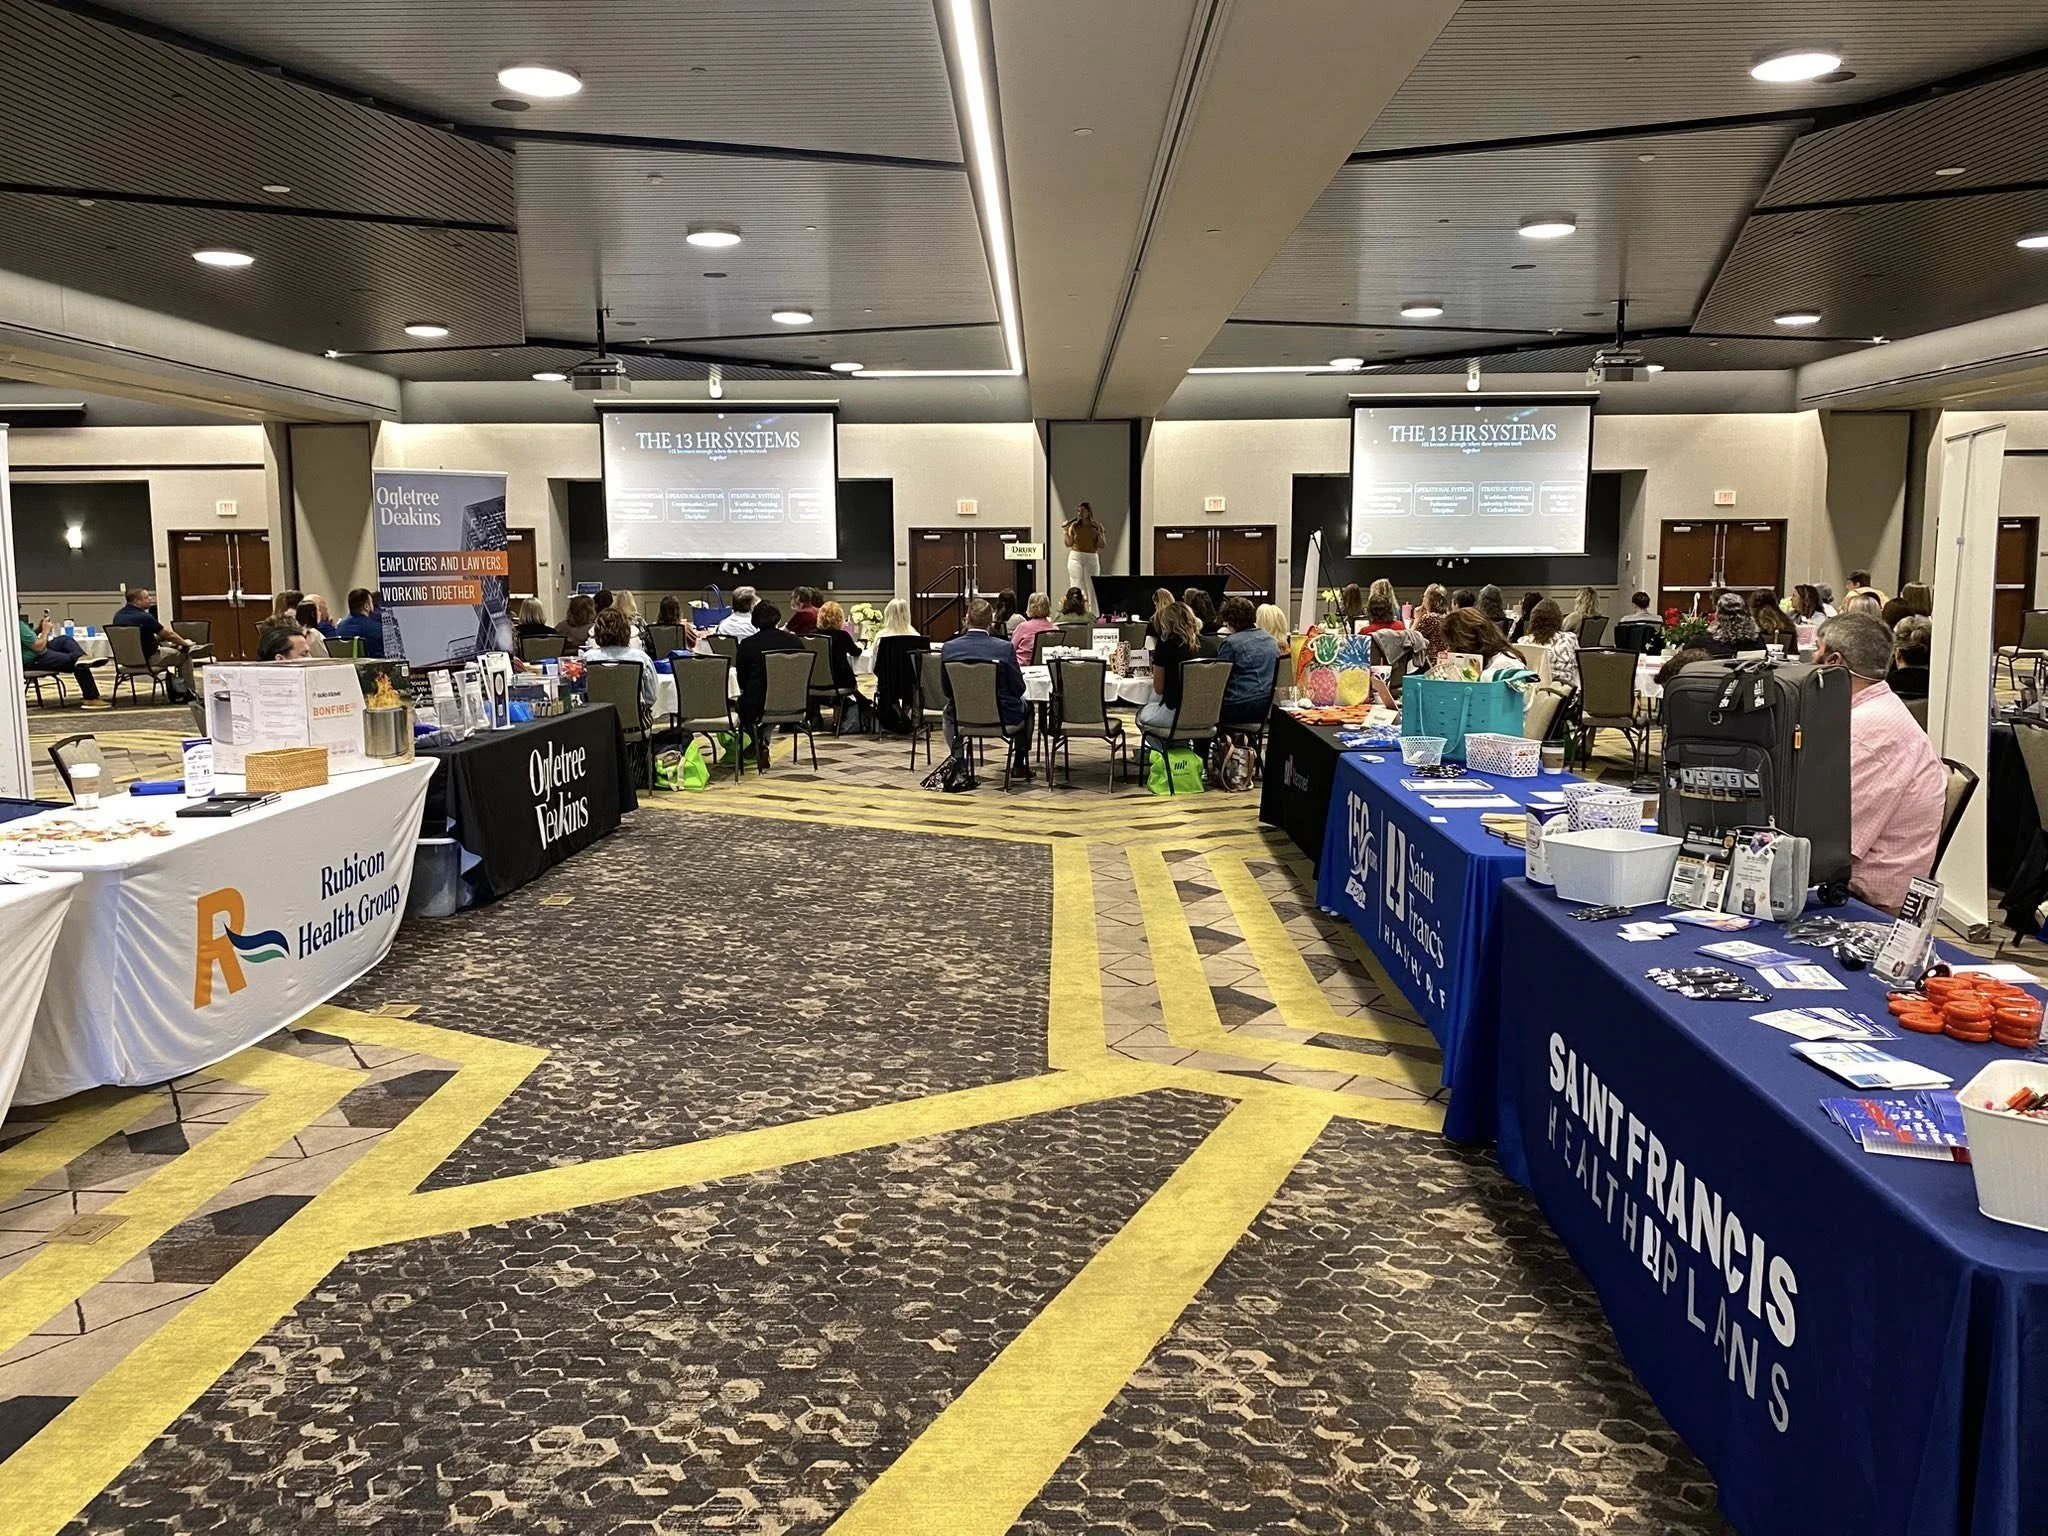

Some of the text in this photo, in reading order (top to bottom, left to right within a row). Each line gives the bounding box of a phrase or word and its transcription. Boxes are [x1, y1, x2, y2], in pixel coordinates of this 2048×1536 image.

[635, 431, 801, 449] THE 13 HR SYSTEMS
[1389, 424, 1556, 442] THE 13 HR SYSTEMS
[376, 486, 440, 510] Ogletree
[380, 507, 442, 526] Deakins
[380, 556, 503, 572] EMPLOYERS AND LAWYERS.
[382, 585, 476, 602] WORKING TOGETHER
[313, 703, 351, 717] BONFIRE
[529, 740, 586, 802] Ogletree
[1730, 775, 1737, 784] 5
[321, 850, 385, 900] Rubicon
[1408, 843, 1435, 904] Saint
[298, 883, 400, 960] Health Group
[1549, 1032, 1798, 1348] SAINT FRANCIS
[1548, 1100, 1790, 1433] HEALTH PLANS
